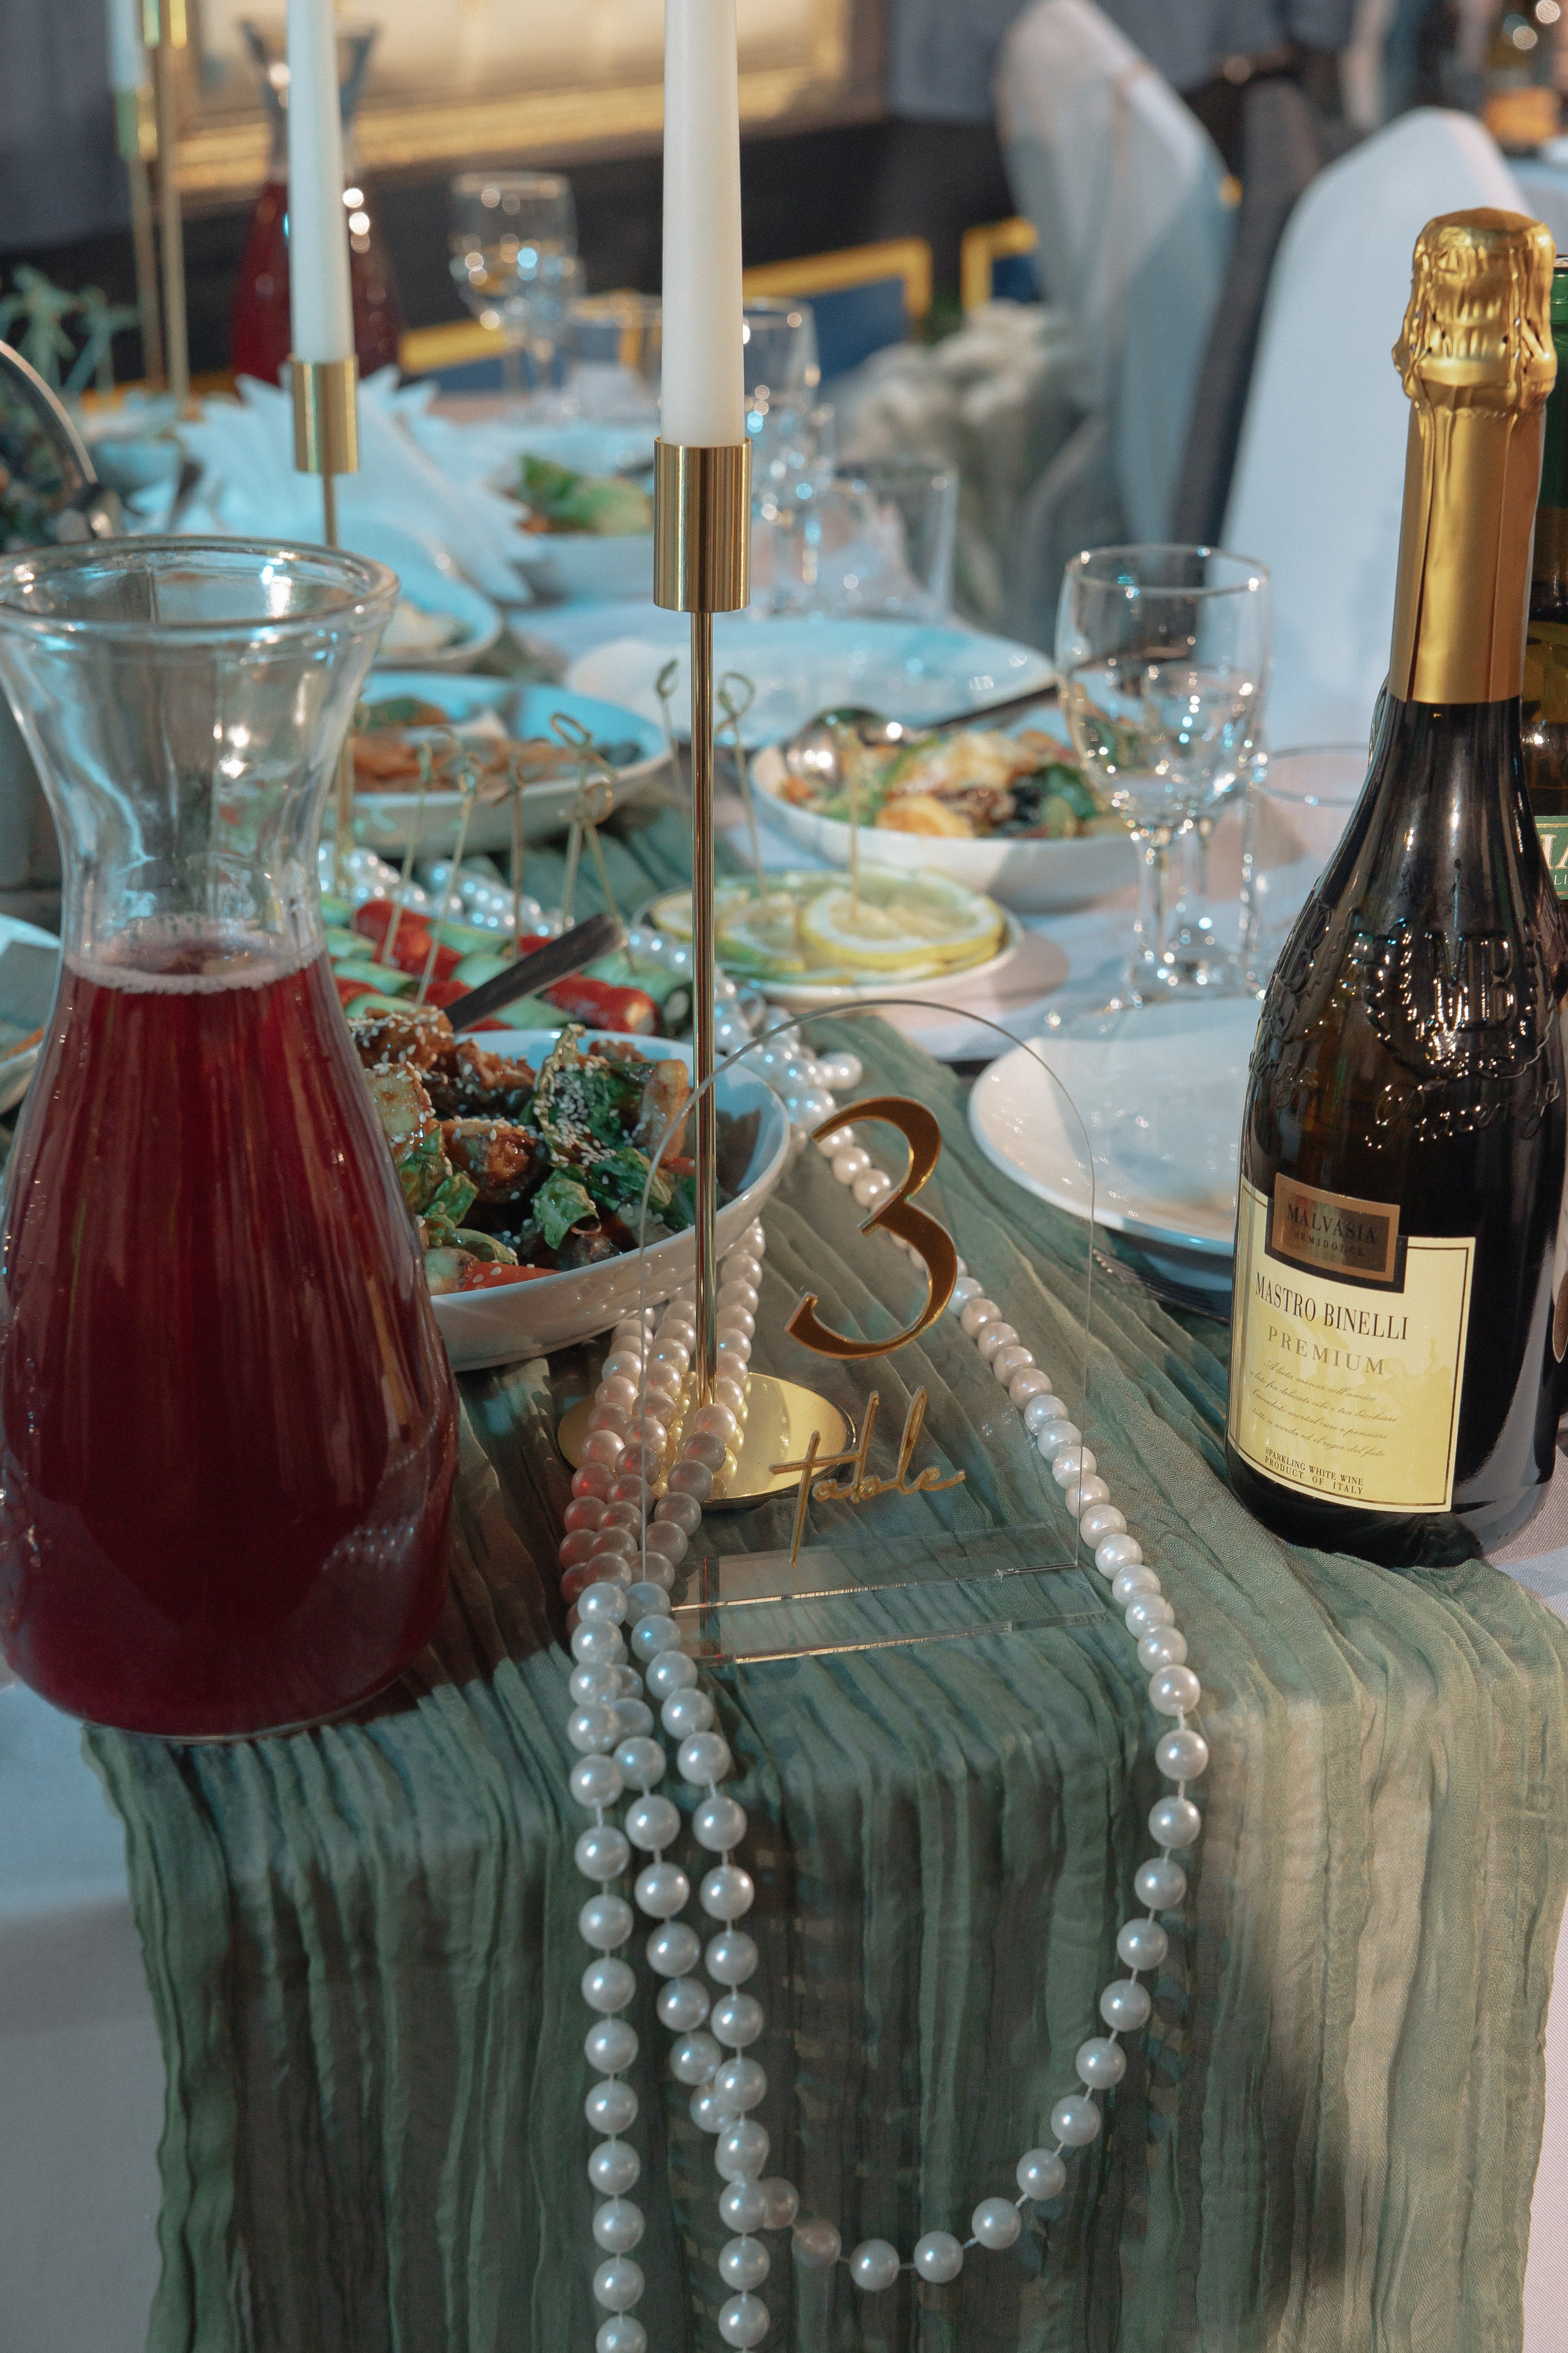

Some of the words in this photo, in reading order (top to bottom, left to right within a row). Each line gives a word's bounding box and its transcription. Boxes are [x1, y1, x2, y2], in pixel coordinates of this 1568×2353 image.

[785, 1096, 957, 1359] 3
[1287, 1204, 1376, 1244] MALVASIA
[1256, 1271, 1316, 1322] MASTRO
[1323, 1302, 1409, 1340] BINELLI
[1267, 1324, 1385, 1375] PREMIUM
[1265, 1446, 1306, 1471] SPARKLING
[1309, 1465, 1336, 1480] WHITE
[1340, 1474, 1364, 1486] WINE
[1265, 1456, 1304, 1479] PRODUCT
[1312, 1475, 1324, 1486] OF
[1333, 1481, 1364, 1495] ITALY
